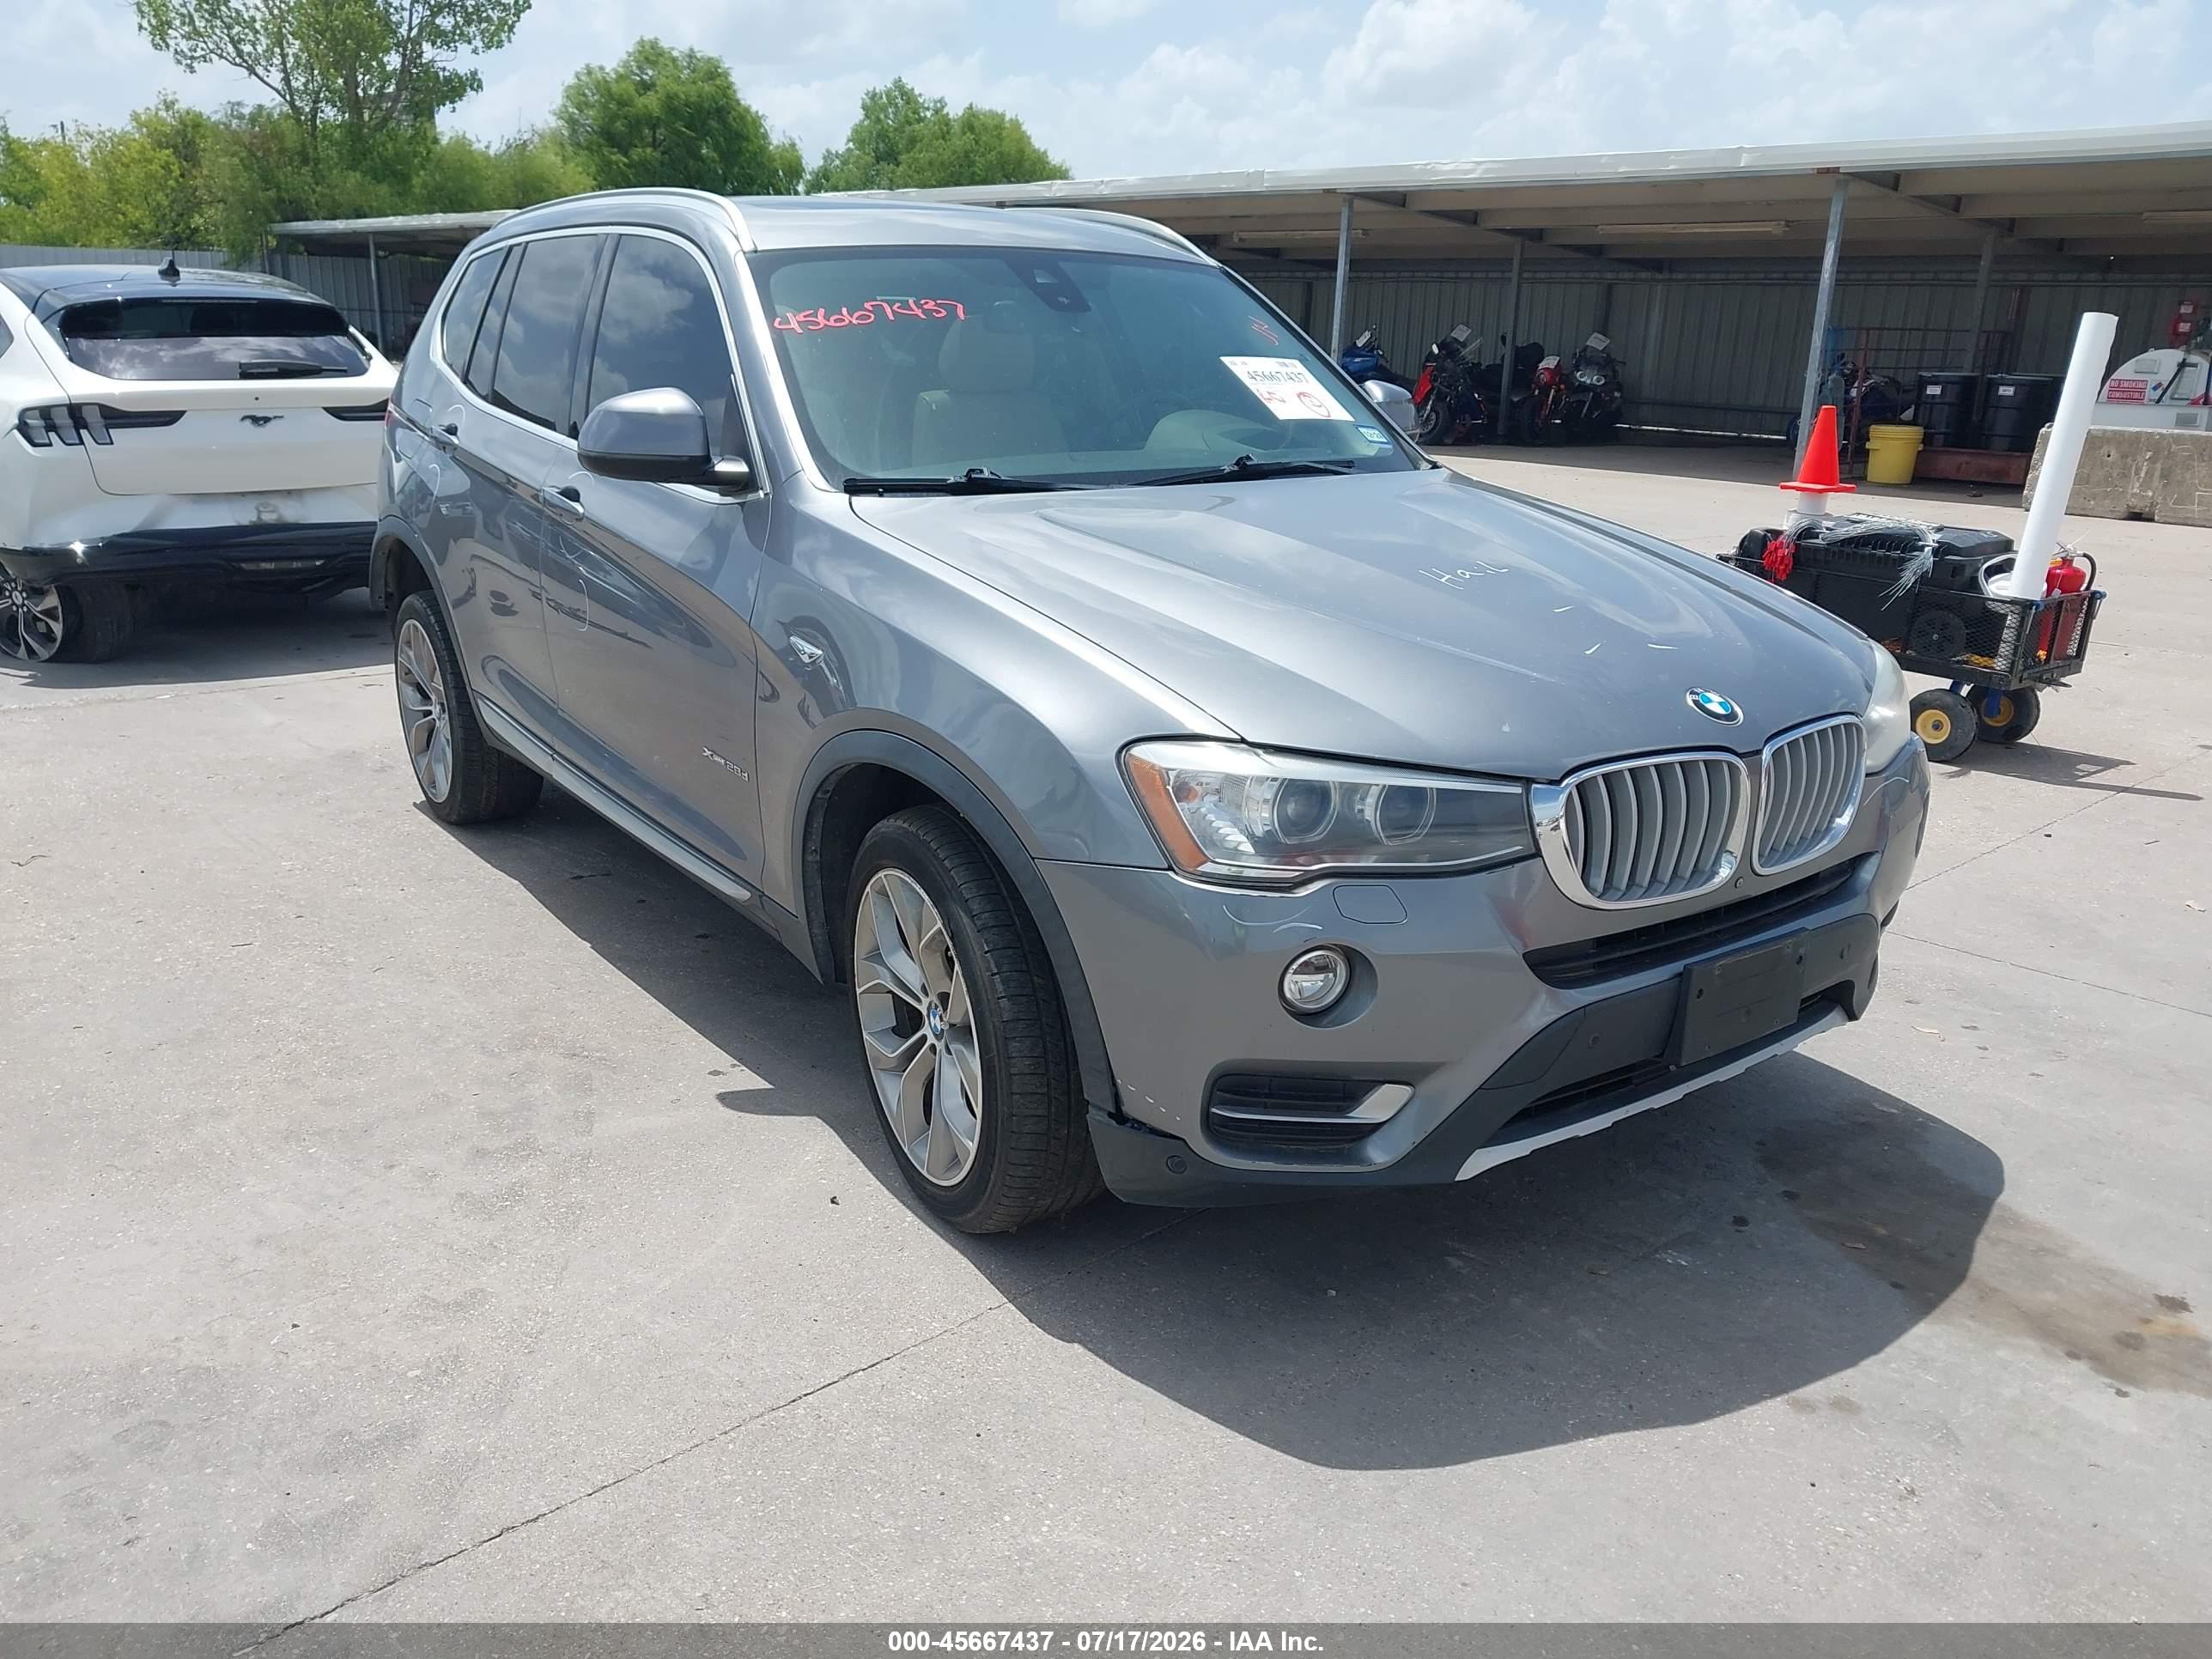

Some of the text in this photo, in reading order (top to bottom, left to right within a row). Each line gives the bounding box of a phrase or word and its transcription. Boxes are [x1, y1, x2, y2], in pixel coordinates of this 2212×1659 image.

[774, 299, 965, 333] 45667437
[1247, 370, 1309, 384] 45667437
[2120, 380, 2147, 388] SMOKING
[2108, 390, 2144, 399] COMBUSTIBLE
[1419, 561, 1510, 590] Hail
